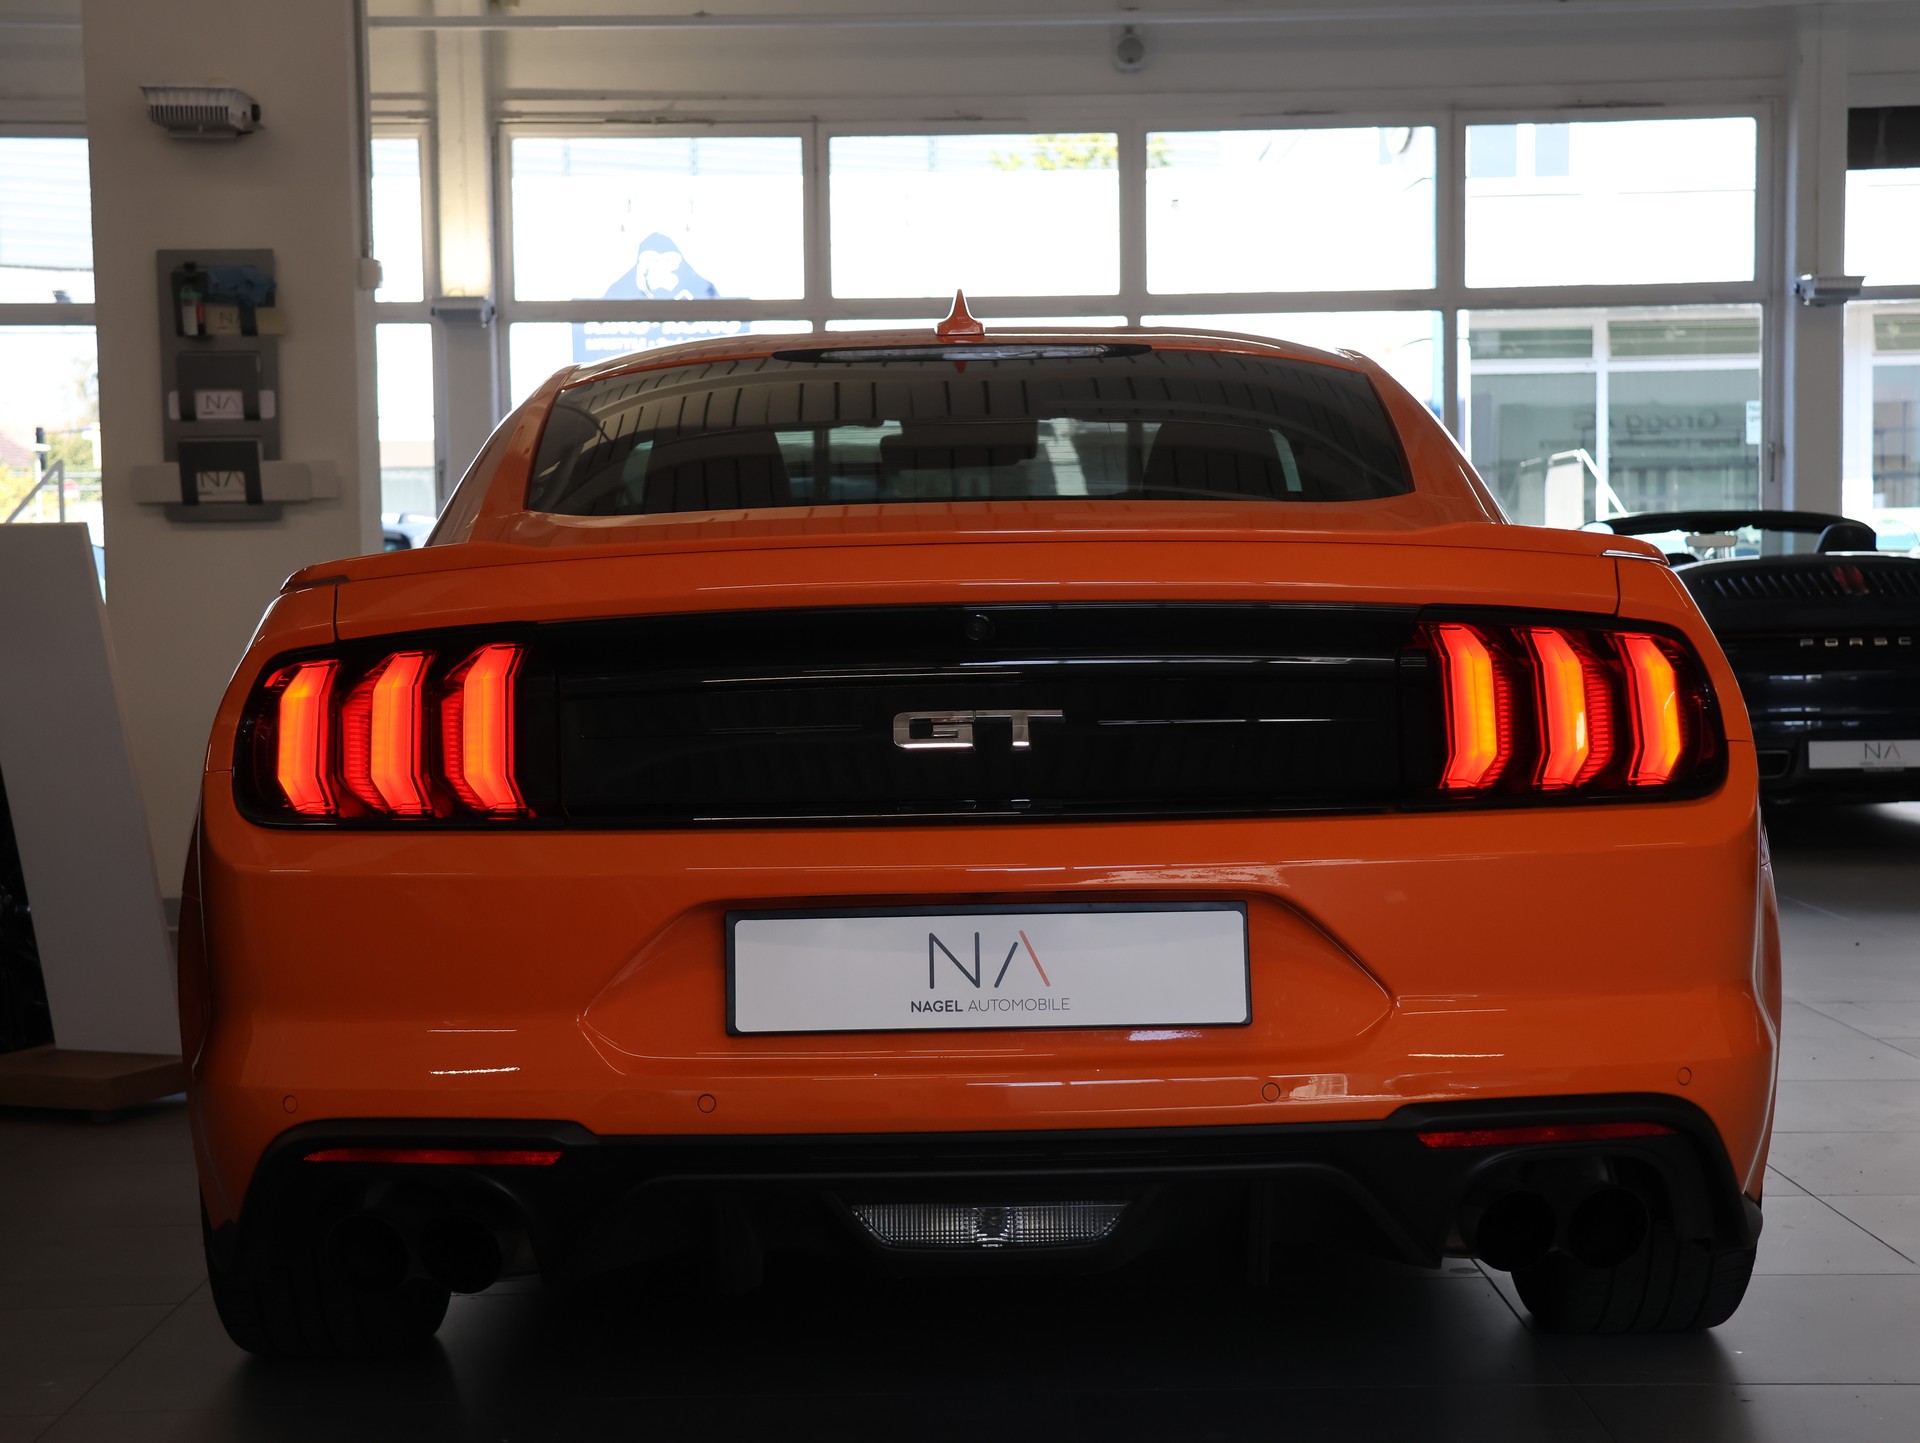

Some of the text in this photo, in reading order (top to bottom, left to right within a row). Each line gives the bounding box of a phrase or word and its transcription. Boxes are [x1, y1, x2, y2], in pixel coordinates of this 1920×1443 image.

[893, 709, 1063, 750] GT
[1864, 742, 1902, 760] NA
[928, 929, 1052, 990] NA
[910, 997, 1071, 1013] NAGEL AUTOMOBILE
